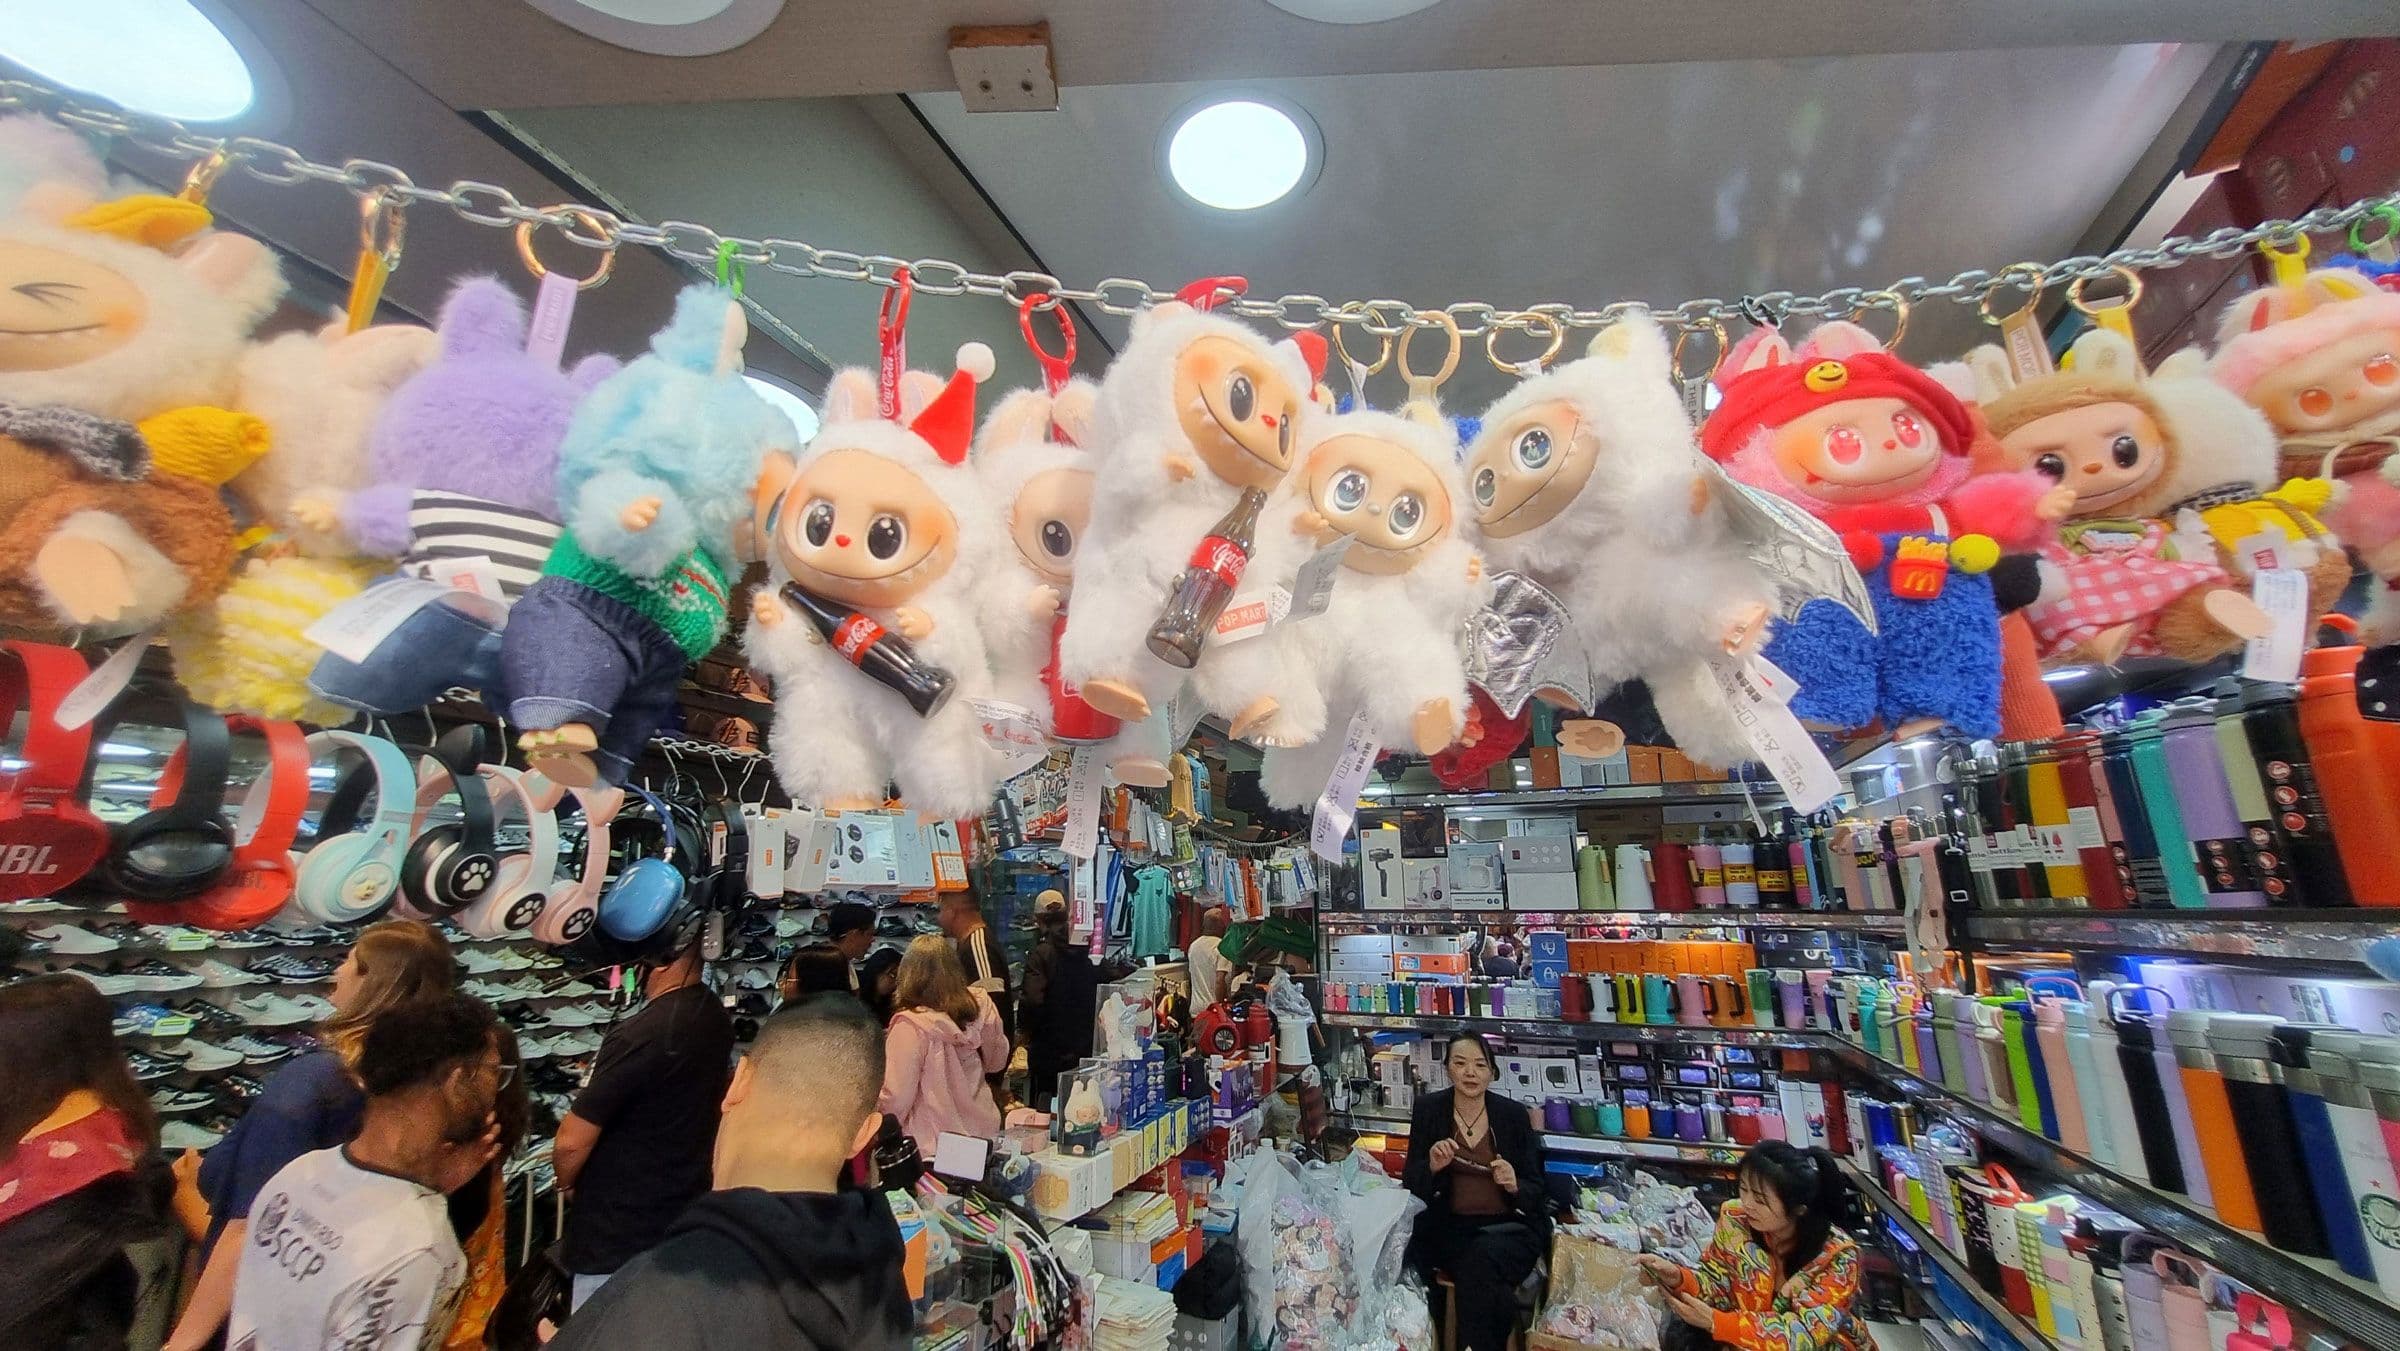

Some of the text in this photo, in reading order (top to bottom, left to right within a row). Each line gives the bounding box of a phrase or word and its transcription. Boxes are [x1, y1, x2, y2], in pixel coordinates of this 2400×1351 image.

[1217, 612, 1239, 630] POP
[1242, 605, 1267, 624] MART
[0, 844, 59, 875] BL
[267, 1226, 327, 1282] SCCP
